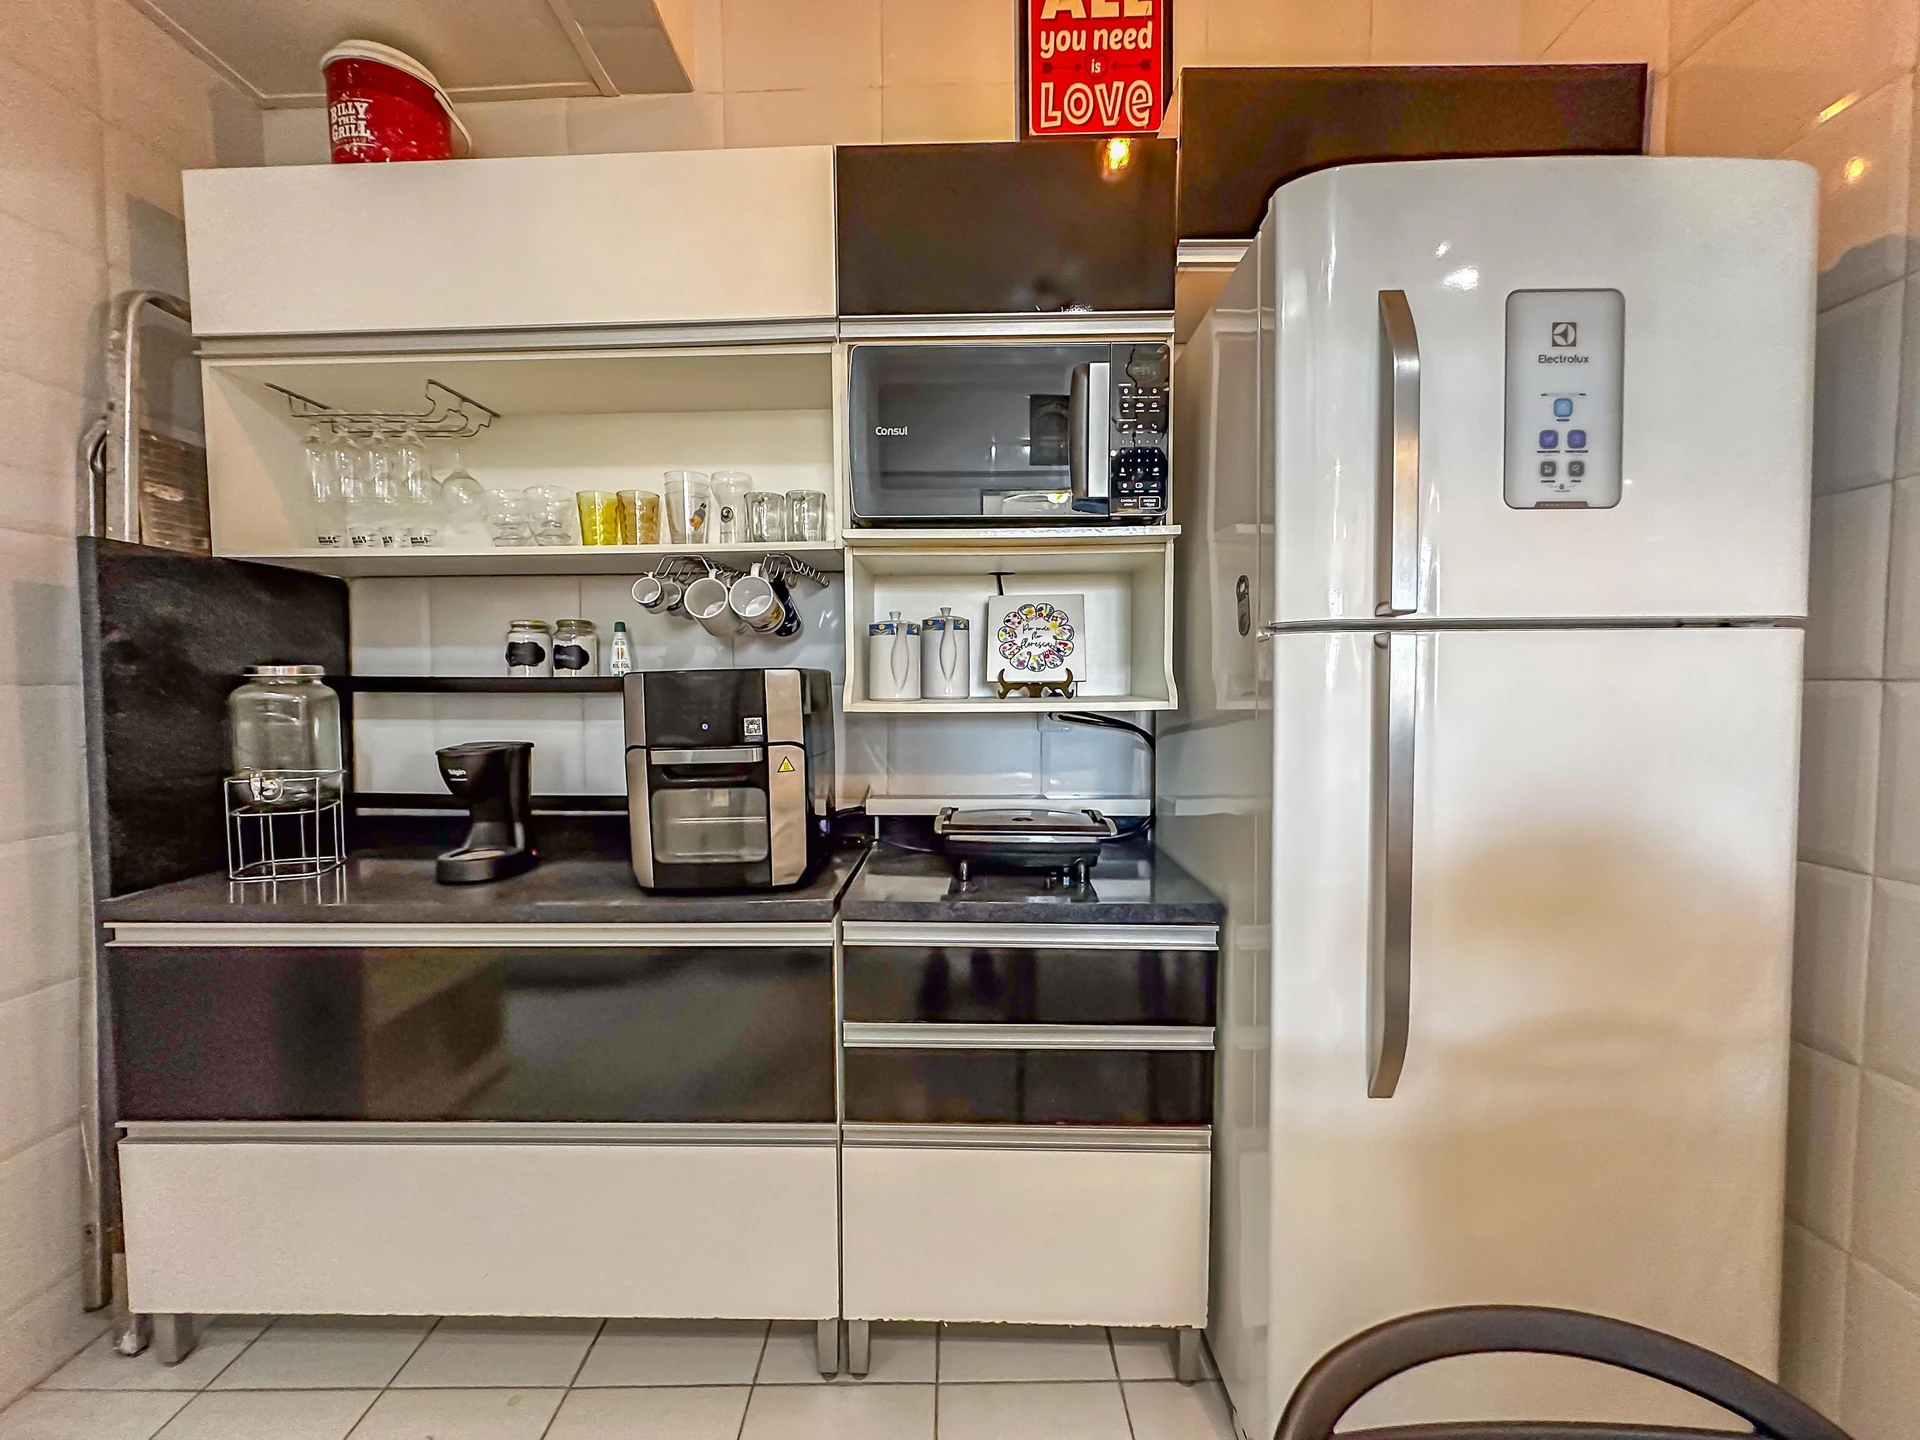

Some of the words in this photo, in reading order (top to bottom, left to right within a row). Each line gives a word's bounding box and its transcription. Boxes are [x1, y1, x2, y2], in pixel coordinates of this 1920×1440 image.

[1040, 29, 1087, 59] you
[1093, 20, 1153, 50] need
[1091, 58, 1101, 73] is
[329, 101, 369, 124] BILLY
[338, 115, 356, 125] THE
[332, 120, 371, 142] GRILL
[1538, 354, 1589, 364] Electrolux
[875, 426, 908, 436] Consul
